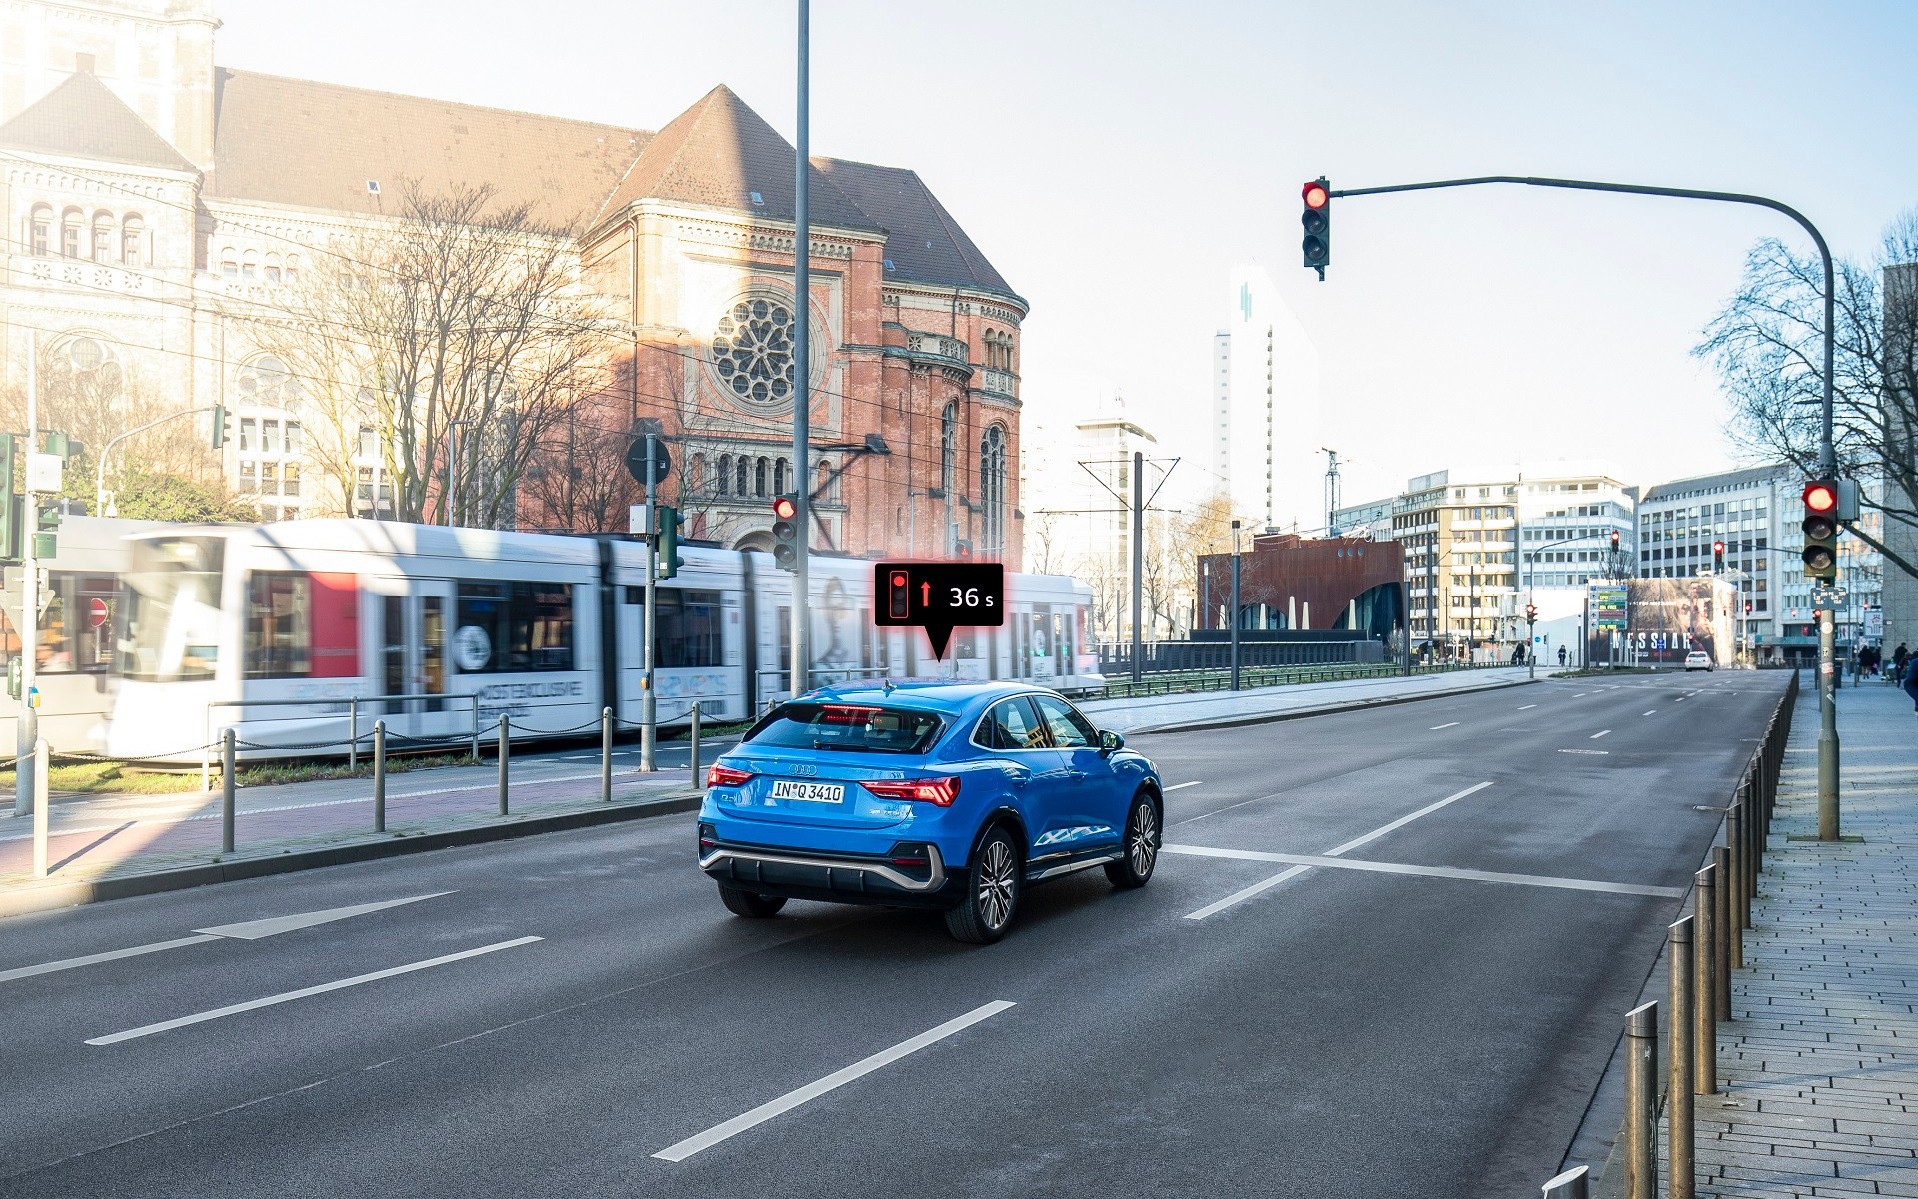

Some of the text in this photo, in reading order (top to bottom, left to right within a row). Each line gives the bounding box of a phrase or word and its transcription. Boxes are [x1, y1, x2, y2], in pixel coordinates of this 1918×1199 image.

[774, 782, 841, 801] IN Q 3410
